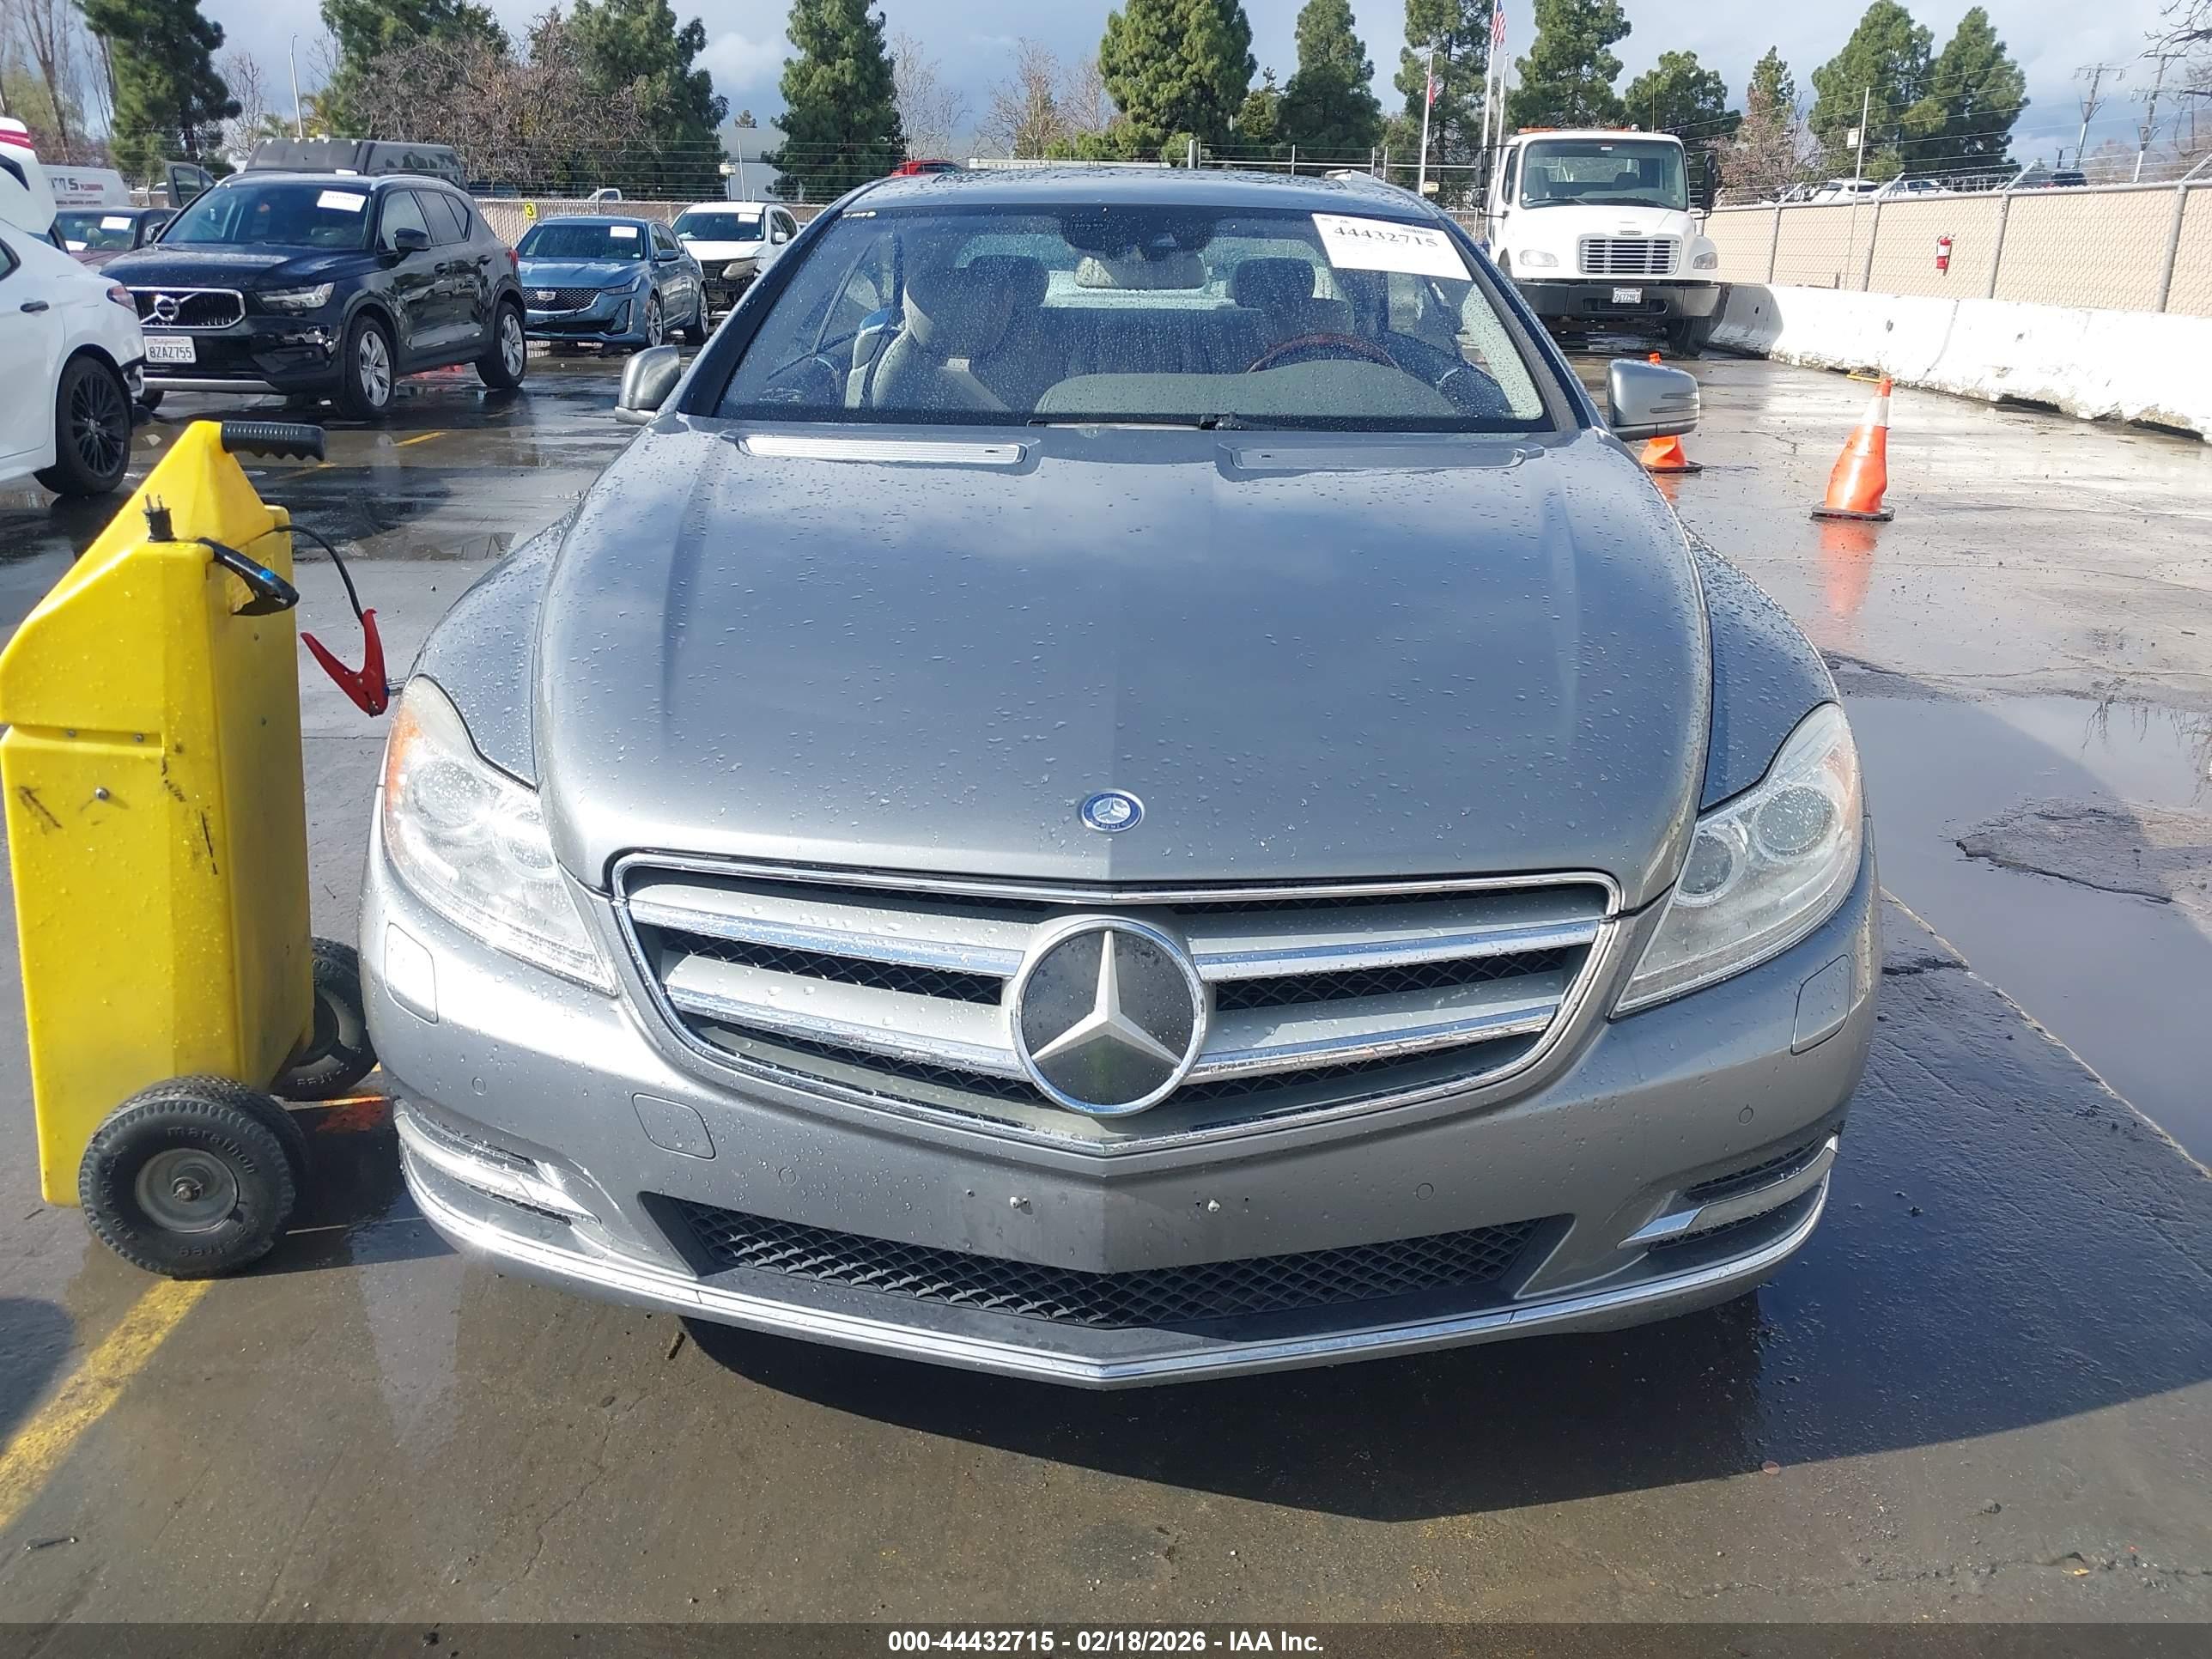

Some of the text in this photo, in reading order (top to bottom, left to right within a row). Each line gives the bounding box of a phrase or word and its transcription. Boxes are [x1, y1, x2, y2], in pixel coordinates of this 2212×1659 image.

[526, 204, 534, 216] 3
[1334, 226, 1439, 247] 44432715
[149, 346, 192, 359] 8ZAZ755
[167, 1126, 256, 1176] marathon
